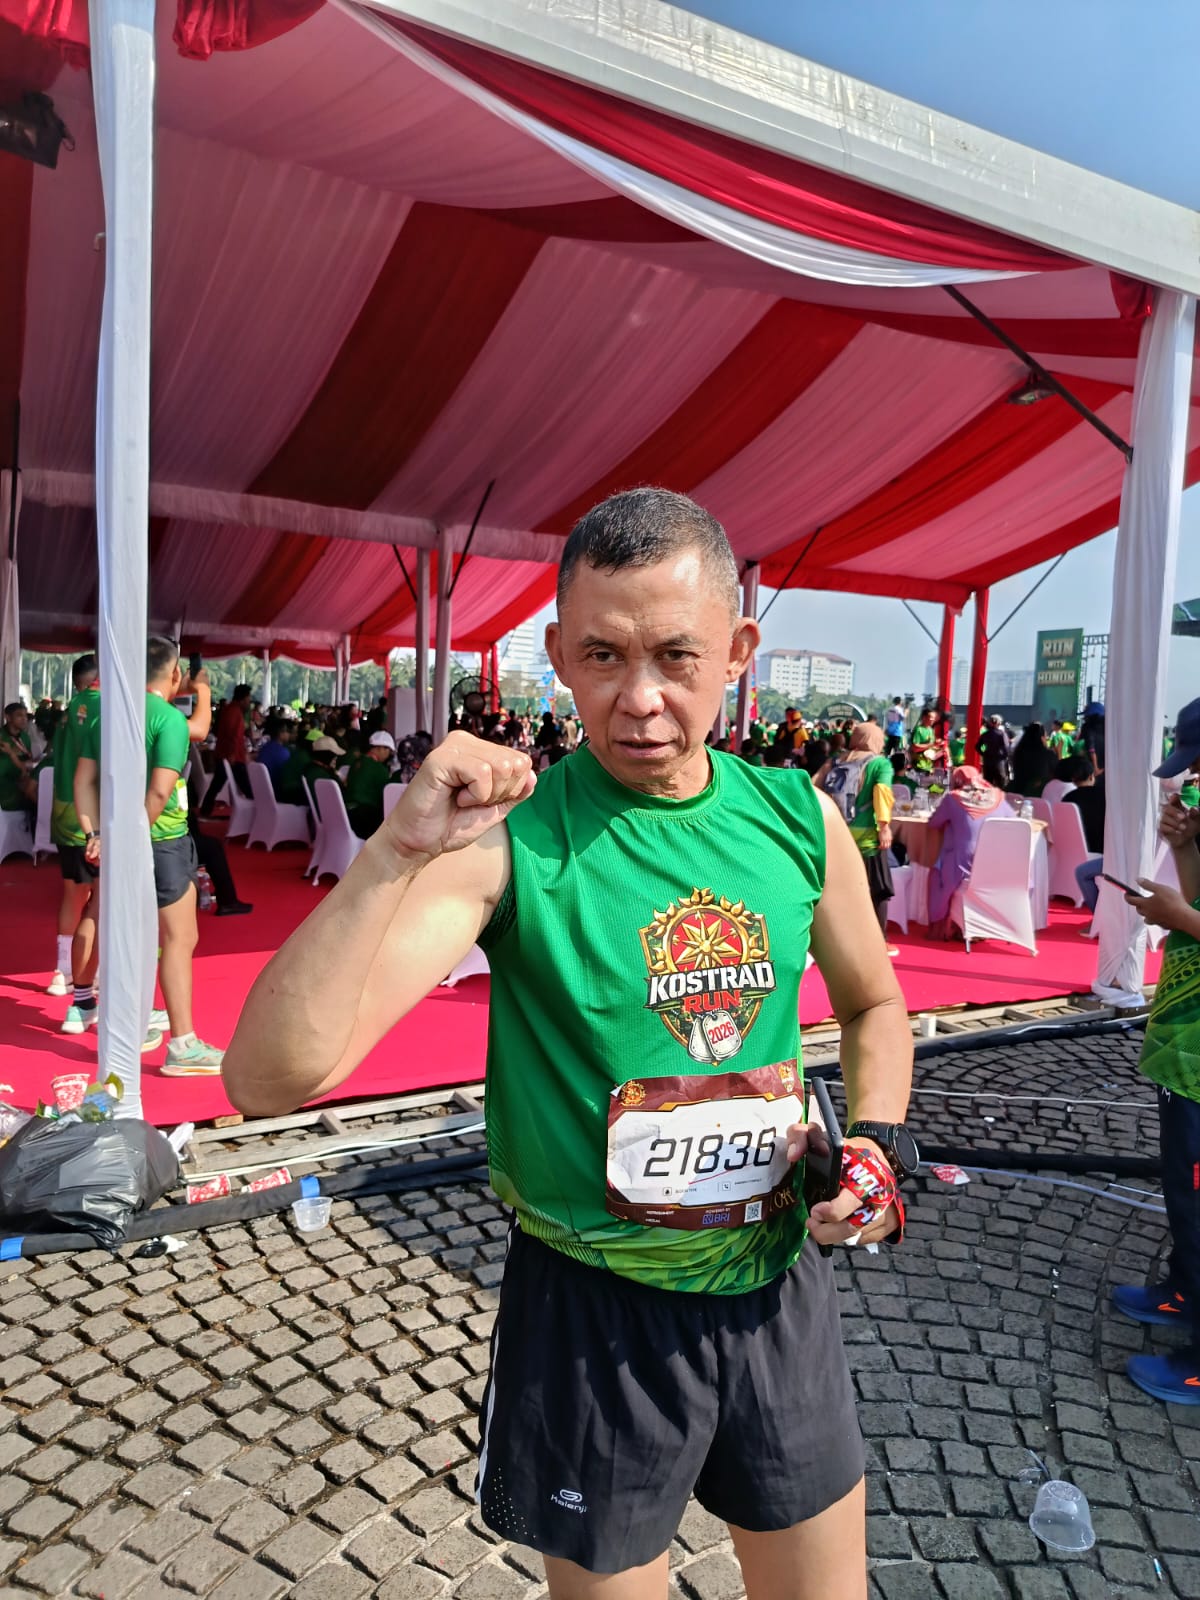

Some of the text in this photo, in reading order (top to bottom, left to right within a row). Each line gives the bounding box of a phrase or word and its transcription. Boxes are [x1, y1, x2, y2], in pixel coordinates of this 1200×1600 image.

[1043, 638, 1075, 656] RUN
[1047, 660, 1066, 669] WITH
[1038, 671, 1075, 685] HONOR
[649, 961, 776, 1005] KOSTRAD
[682, 989, 743, 1014] RUN
[708, 1021, 735, 1044] 2026
[643, 1126, 777, 1177] 21836
[714, 1212, 730, 1223] BRI
